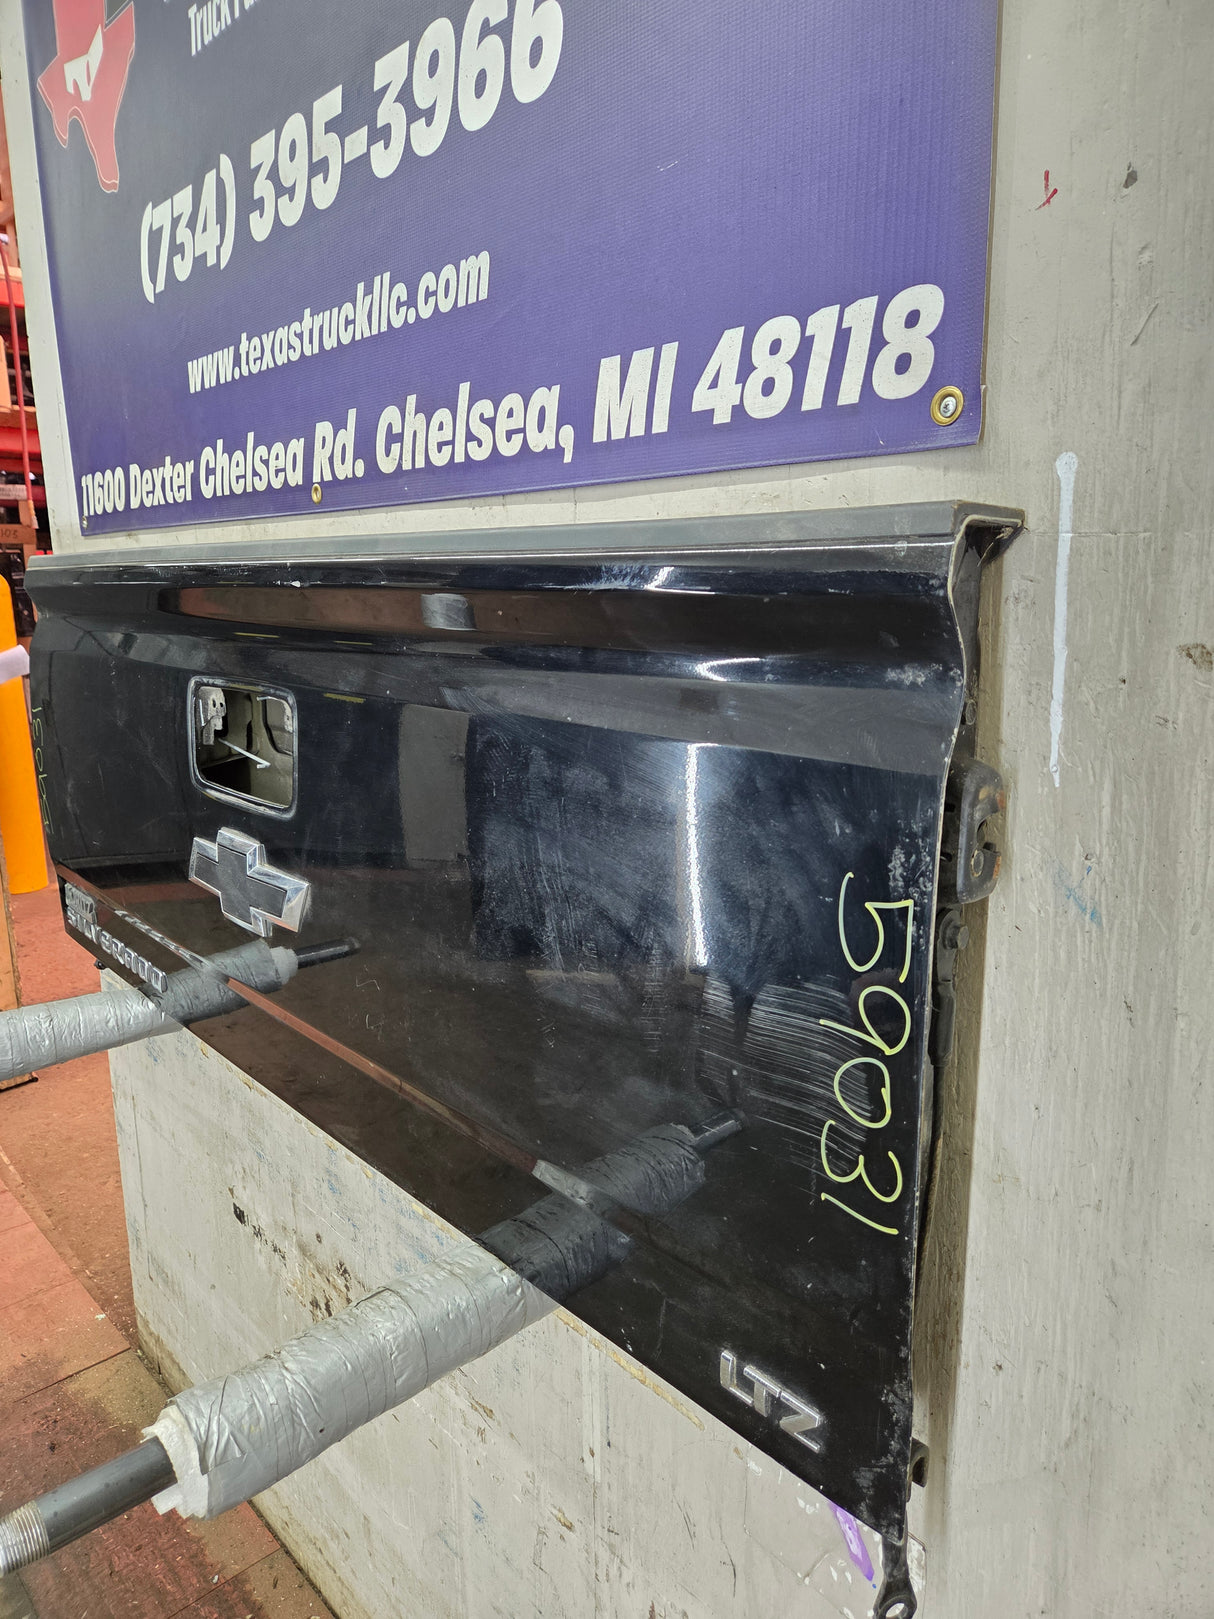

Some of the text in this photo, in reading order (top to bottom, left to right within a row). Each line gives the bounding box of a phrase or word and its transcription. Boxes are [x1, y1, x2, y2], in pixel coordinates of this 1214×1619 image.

[141, 0, 563, 305] (734) 395-3966
[81, 284, 945, 516] 11600 Dexter Chelsea Rd. Chelsea, MI 48118
[187, 251, 490, 394] www.texastruckllc.com
[66, 906, 168, 994] SILVERADO
[820, 872, 914, 1234] 59031
[720, 1350, 822, 1453] LTZ
